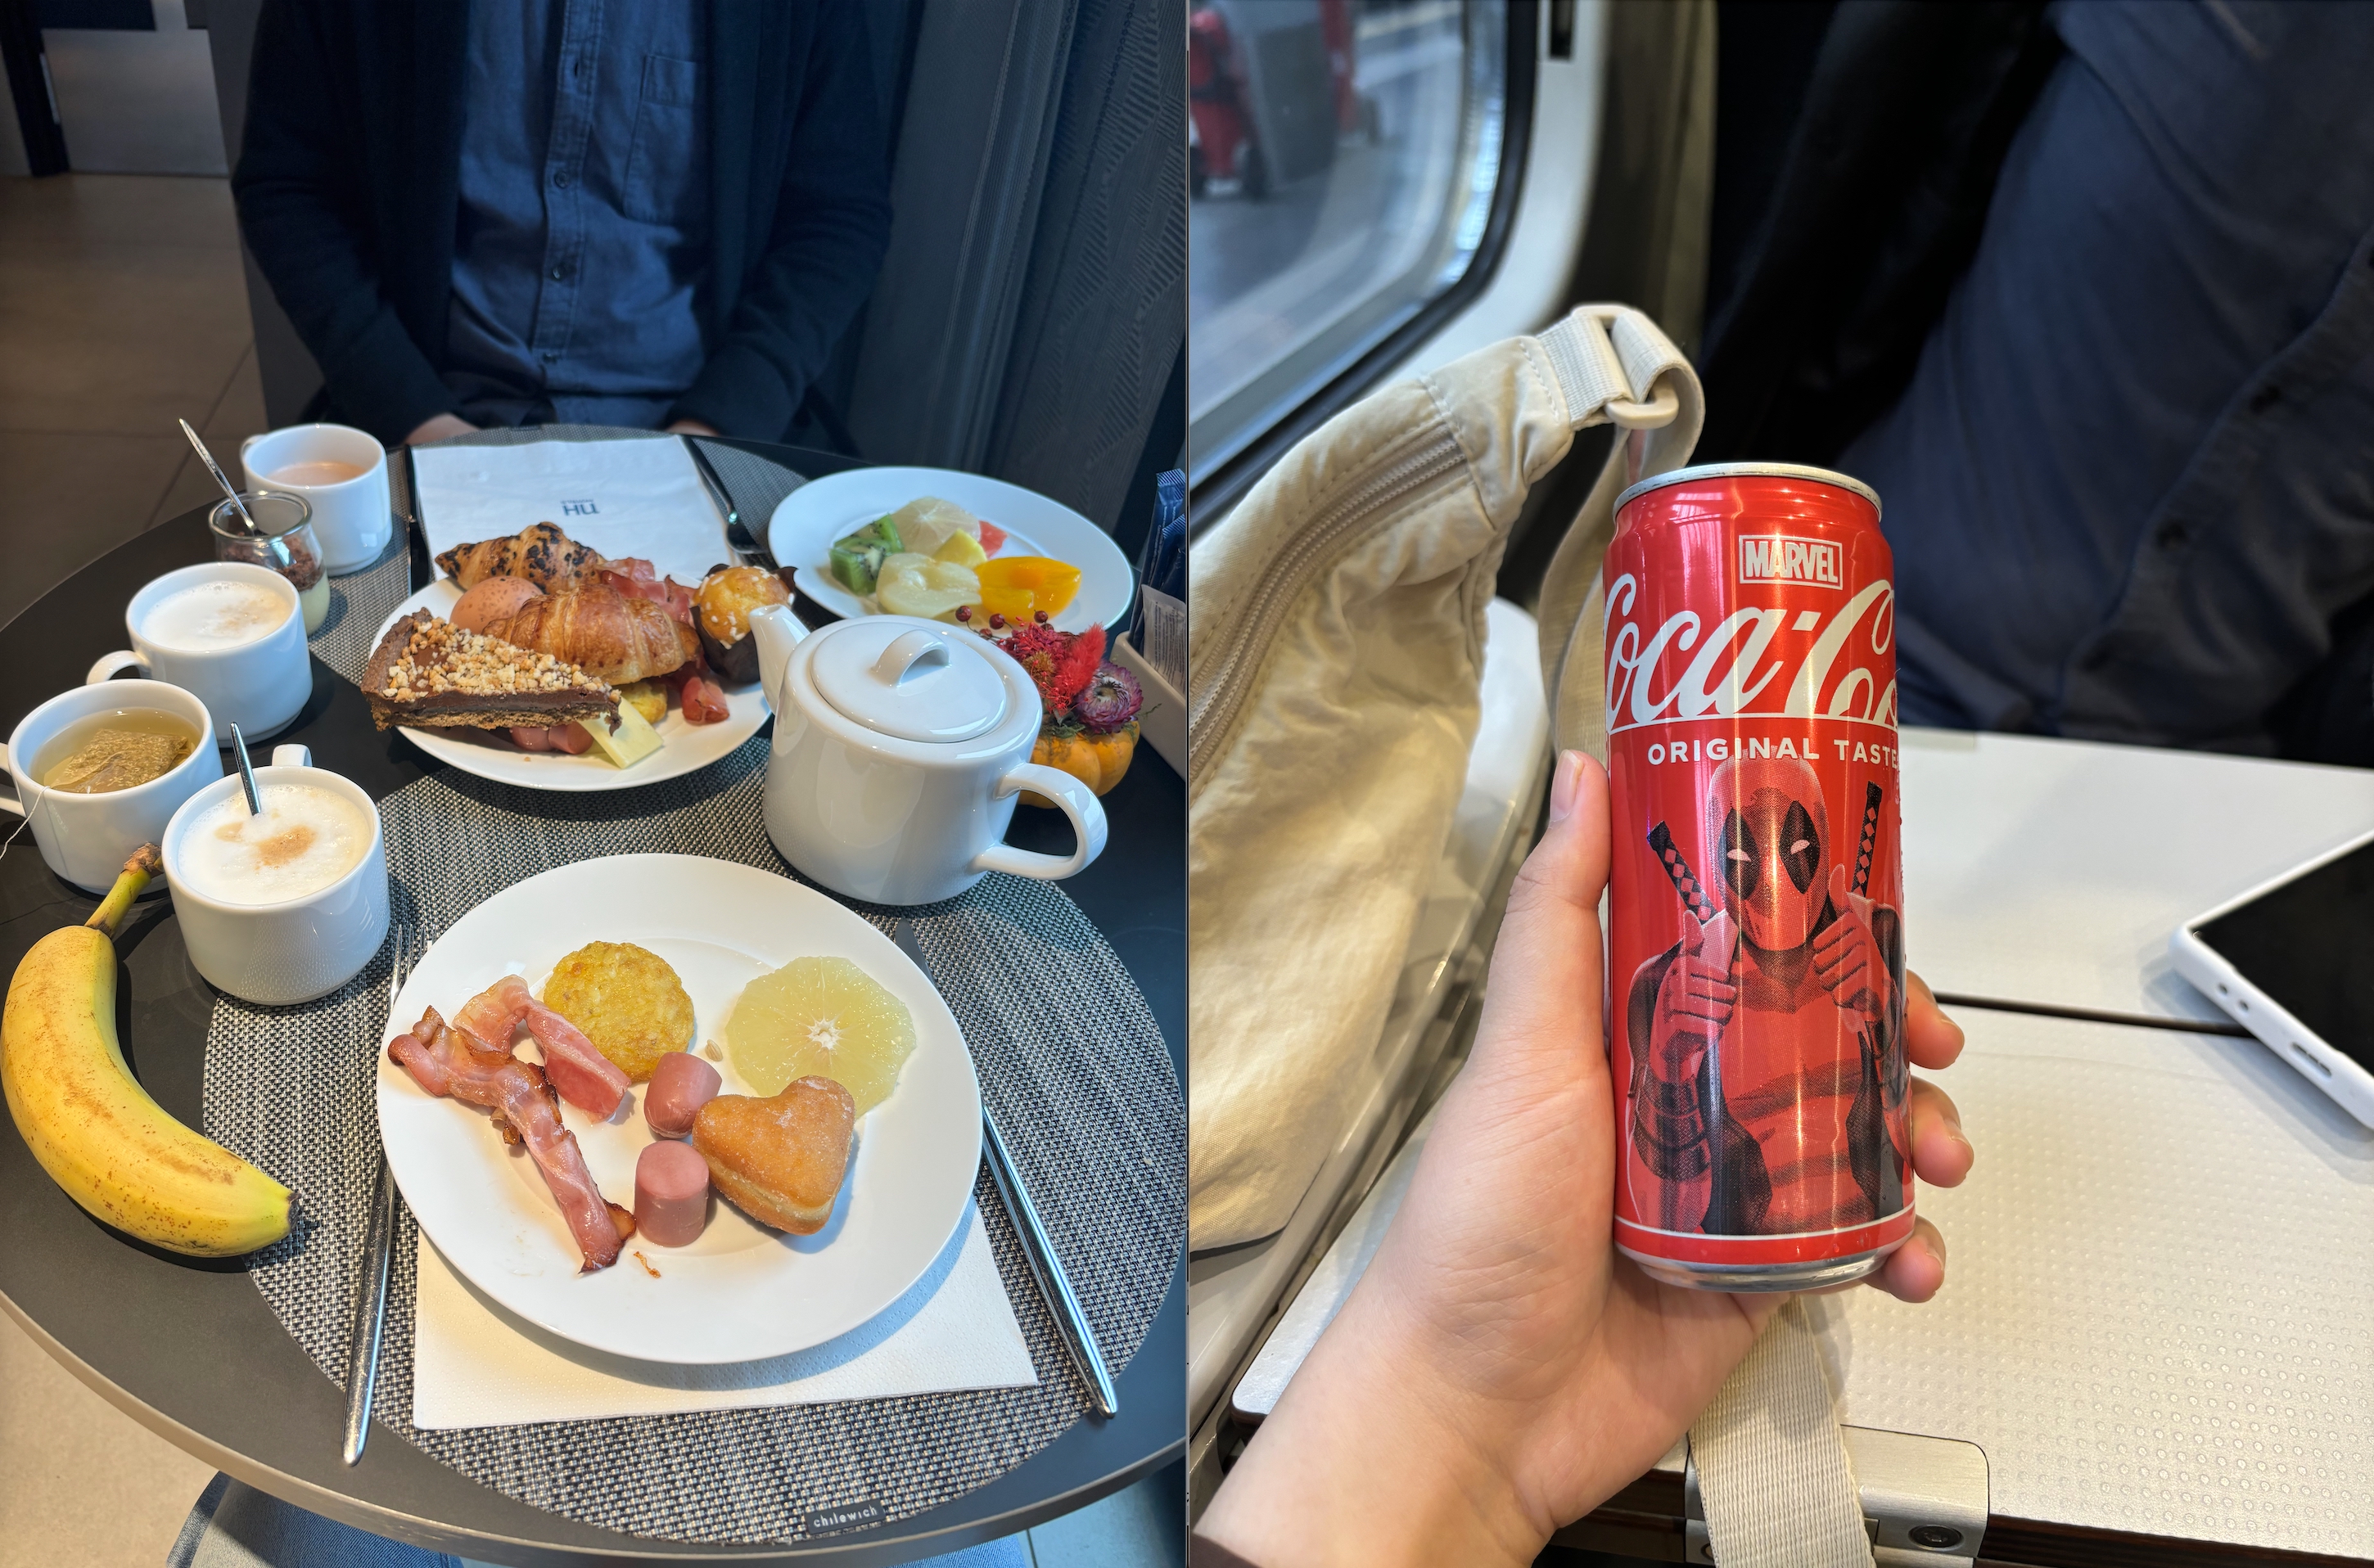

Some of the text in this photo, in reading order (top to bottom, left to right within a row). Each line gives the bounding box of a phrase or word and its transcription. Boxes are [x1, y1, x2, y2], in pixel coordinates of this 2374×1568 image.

[1744, 539, 1839, 583] MARVEL
[1648, 737, 1898, 769] ORIGINAL TASTE
[814, 1504, 878, 1528] chilewich
